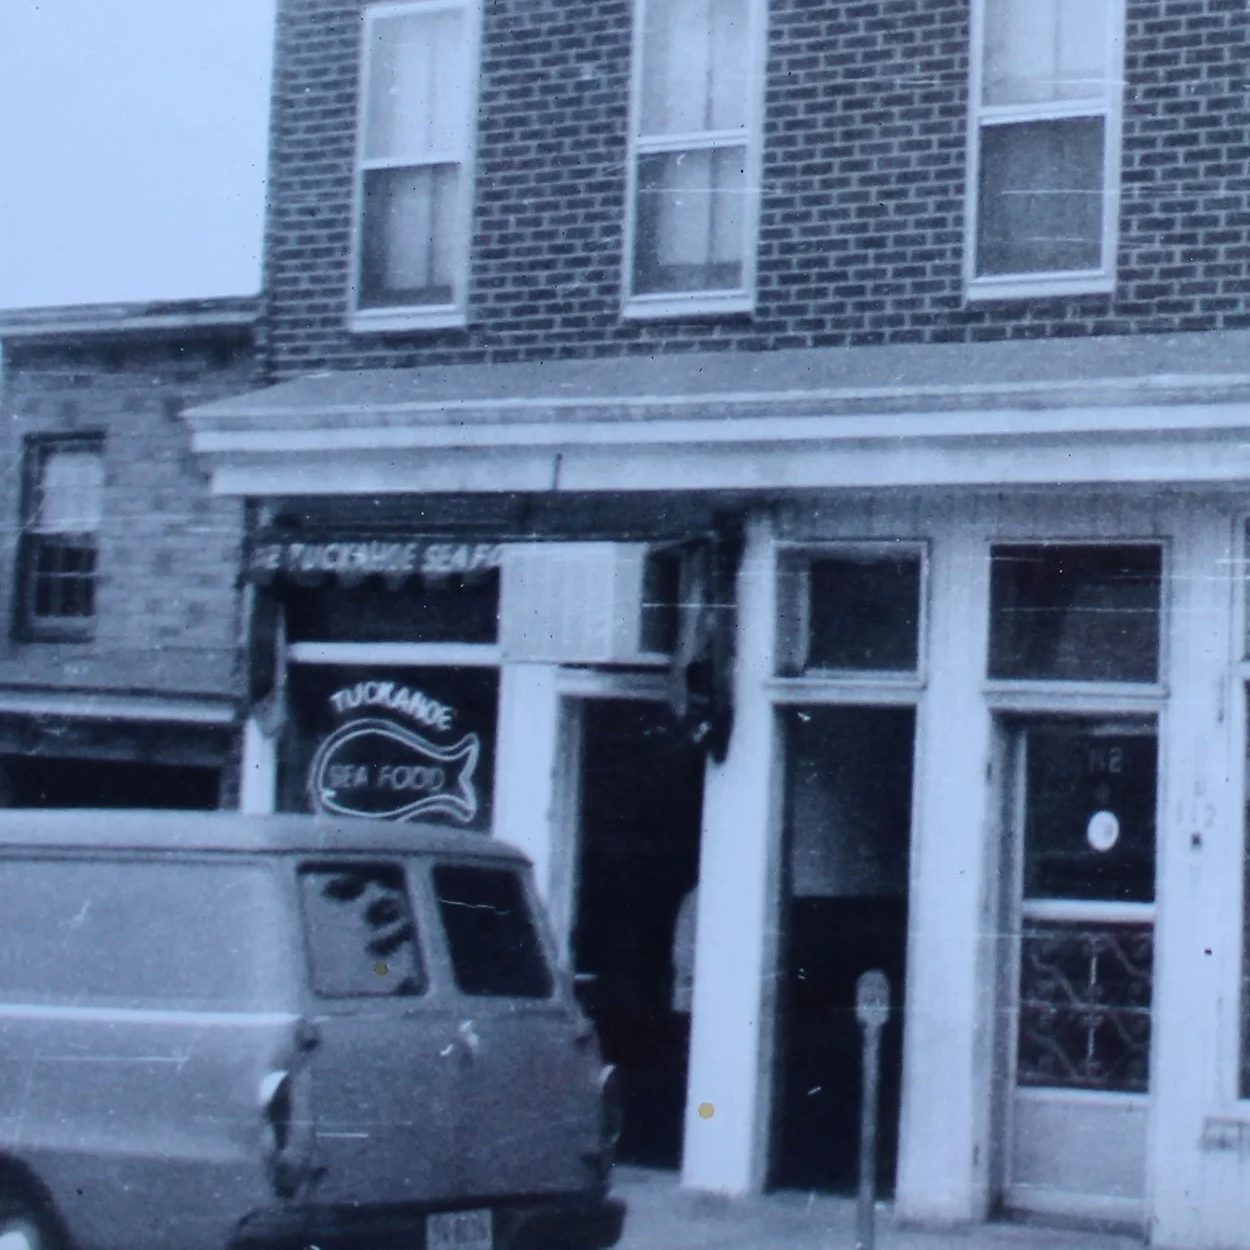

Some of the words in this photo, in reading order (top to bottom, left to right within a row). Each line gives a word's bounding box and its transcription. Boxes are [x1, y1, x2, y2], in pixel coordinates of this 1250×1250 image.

[329, 680, 454, 731] TUCKAHOE
[331, 764, 368, 789] SEA
[379, 765, 446, 791] FOOD
